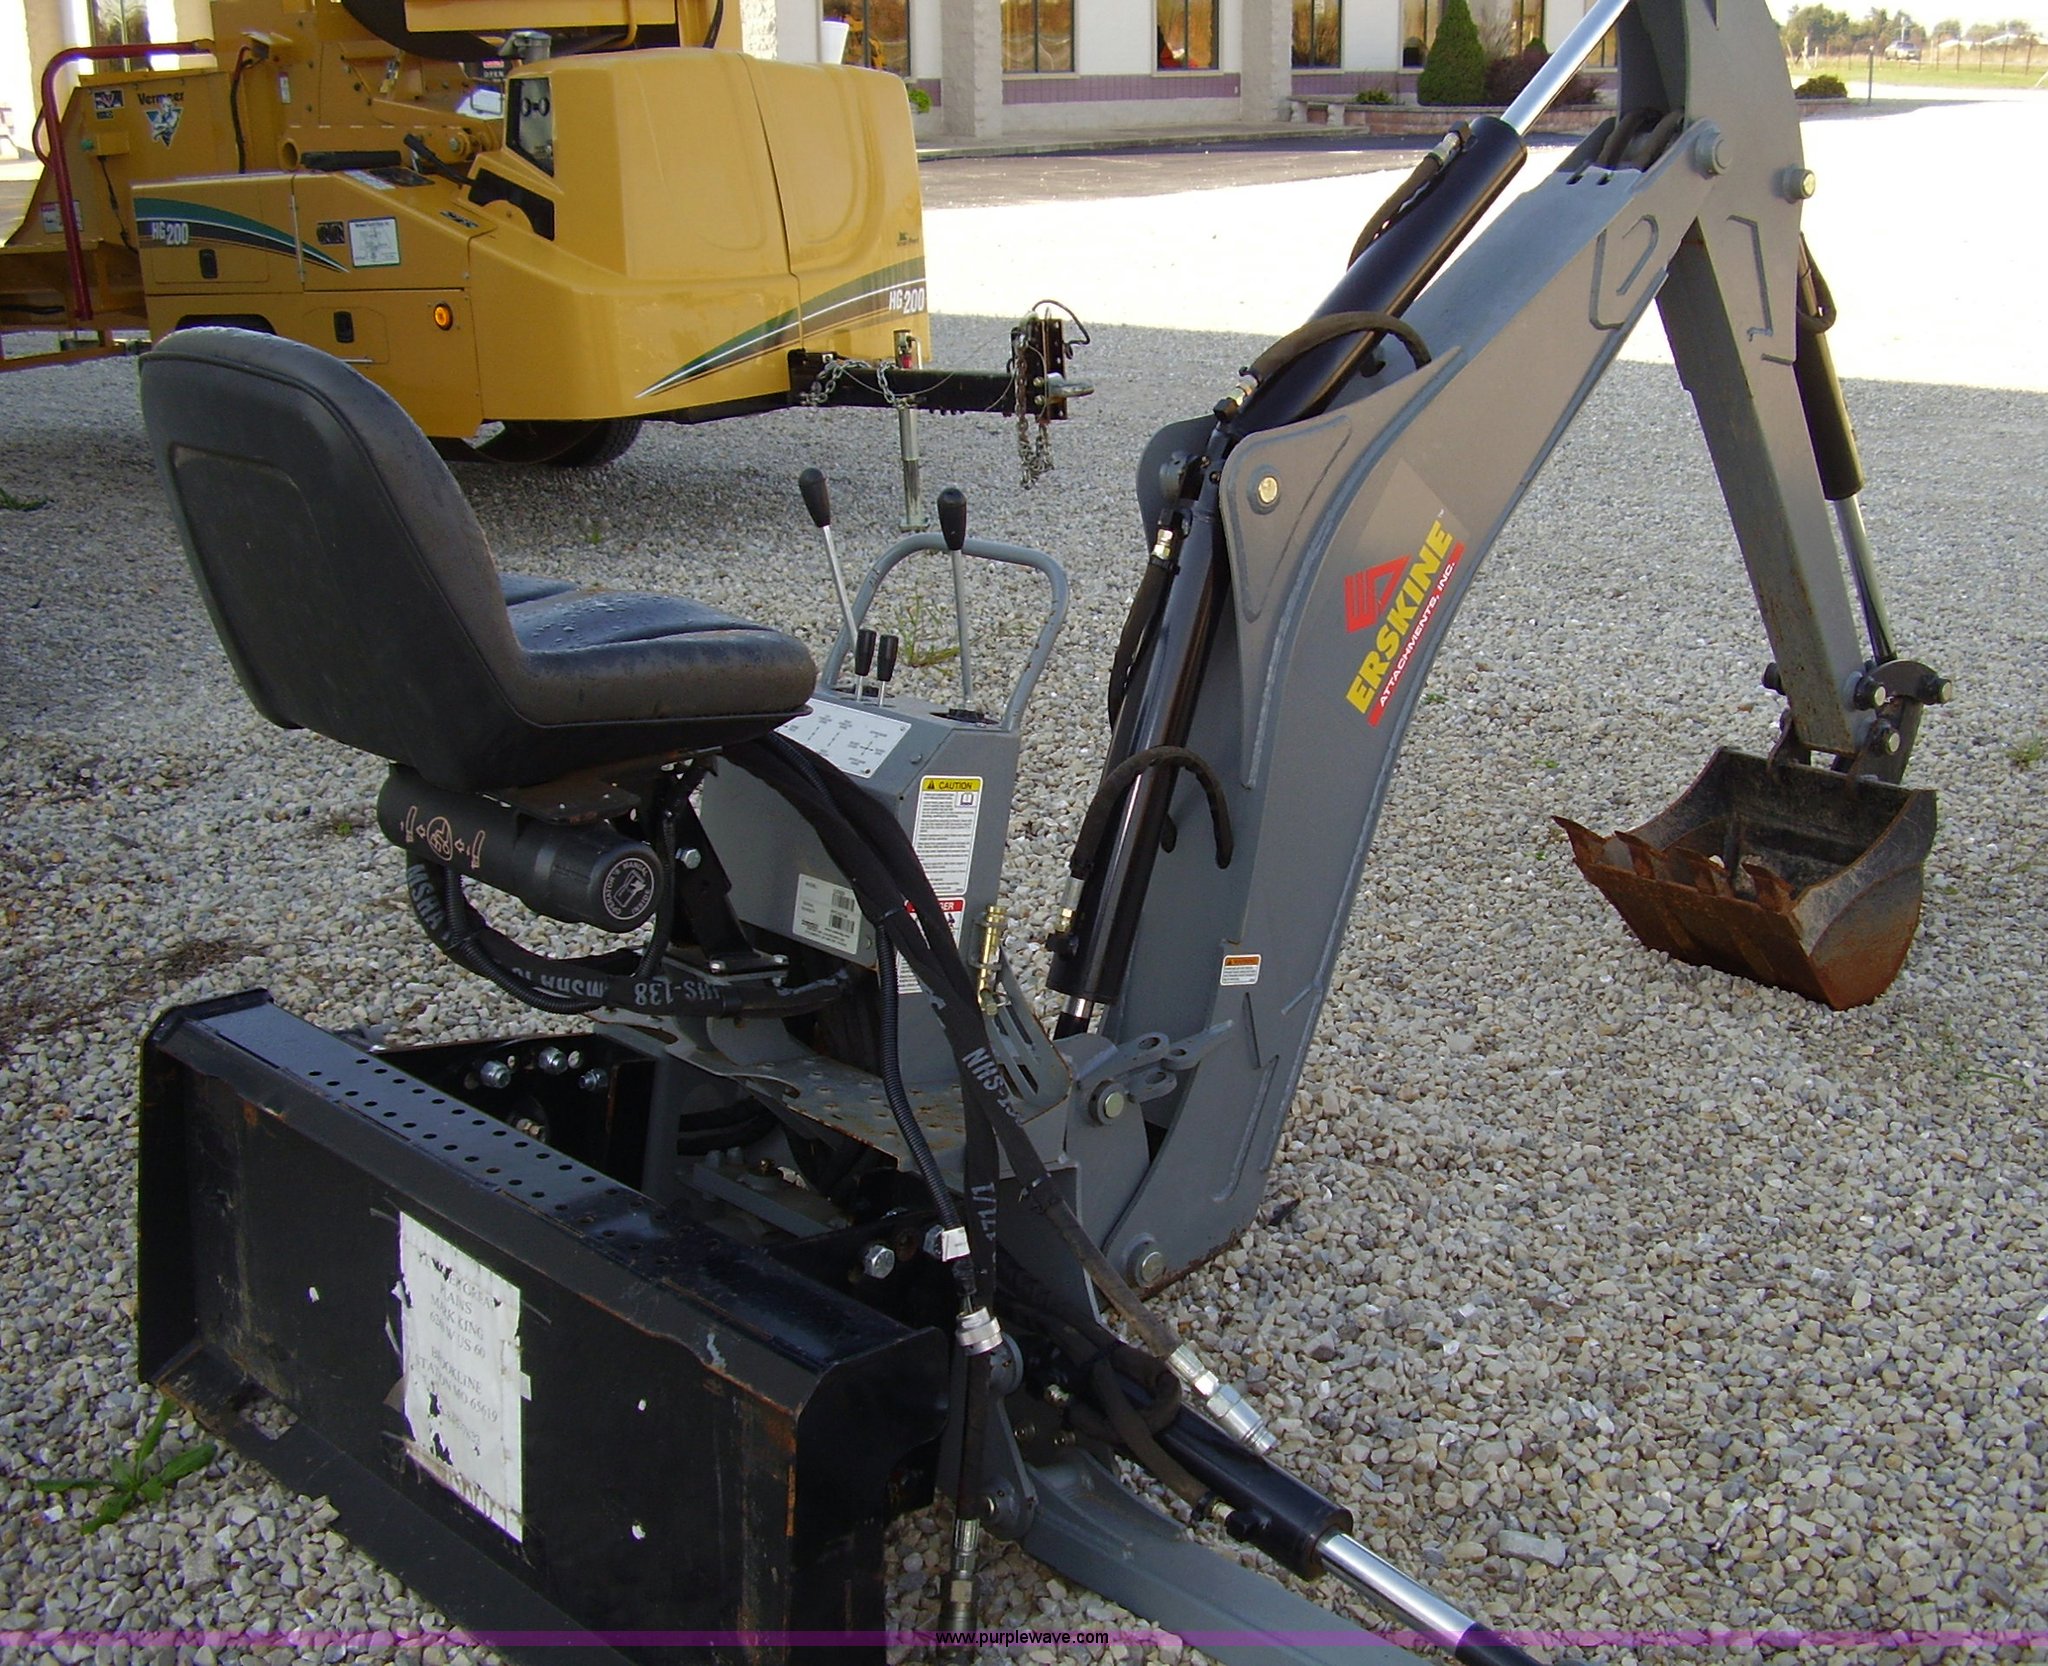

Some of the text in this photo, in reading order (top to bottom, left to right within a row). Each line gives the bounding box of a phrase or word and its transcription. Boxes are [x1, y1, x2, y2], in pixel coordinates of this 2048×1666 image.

[1436, 562, 1455, 592] INC.
[1346, 519, 1454, 714] ERSKINE
[938, 781, 973, 790] CAUTION
[408, 864, 443, 930] MSHA
[458, 1315, 484, 1340] KING
